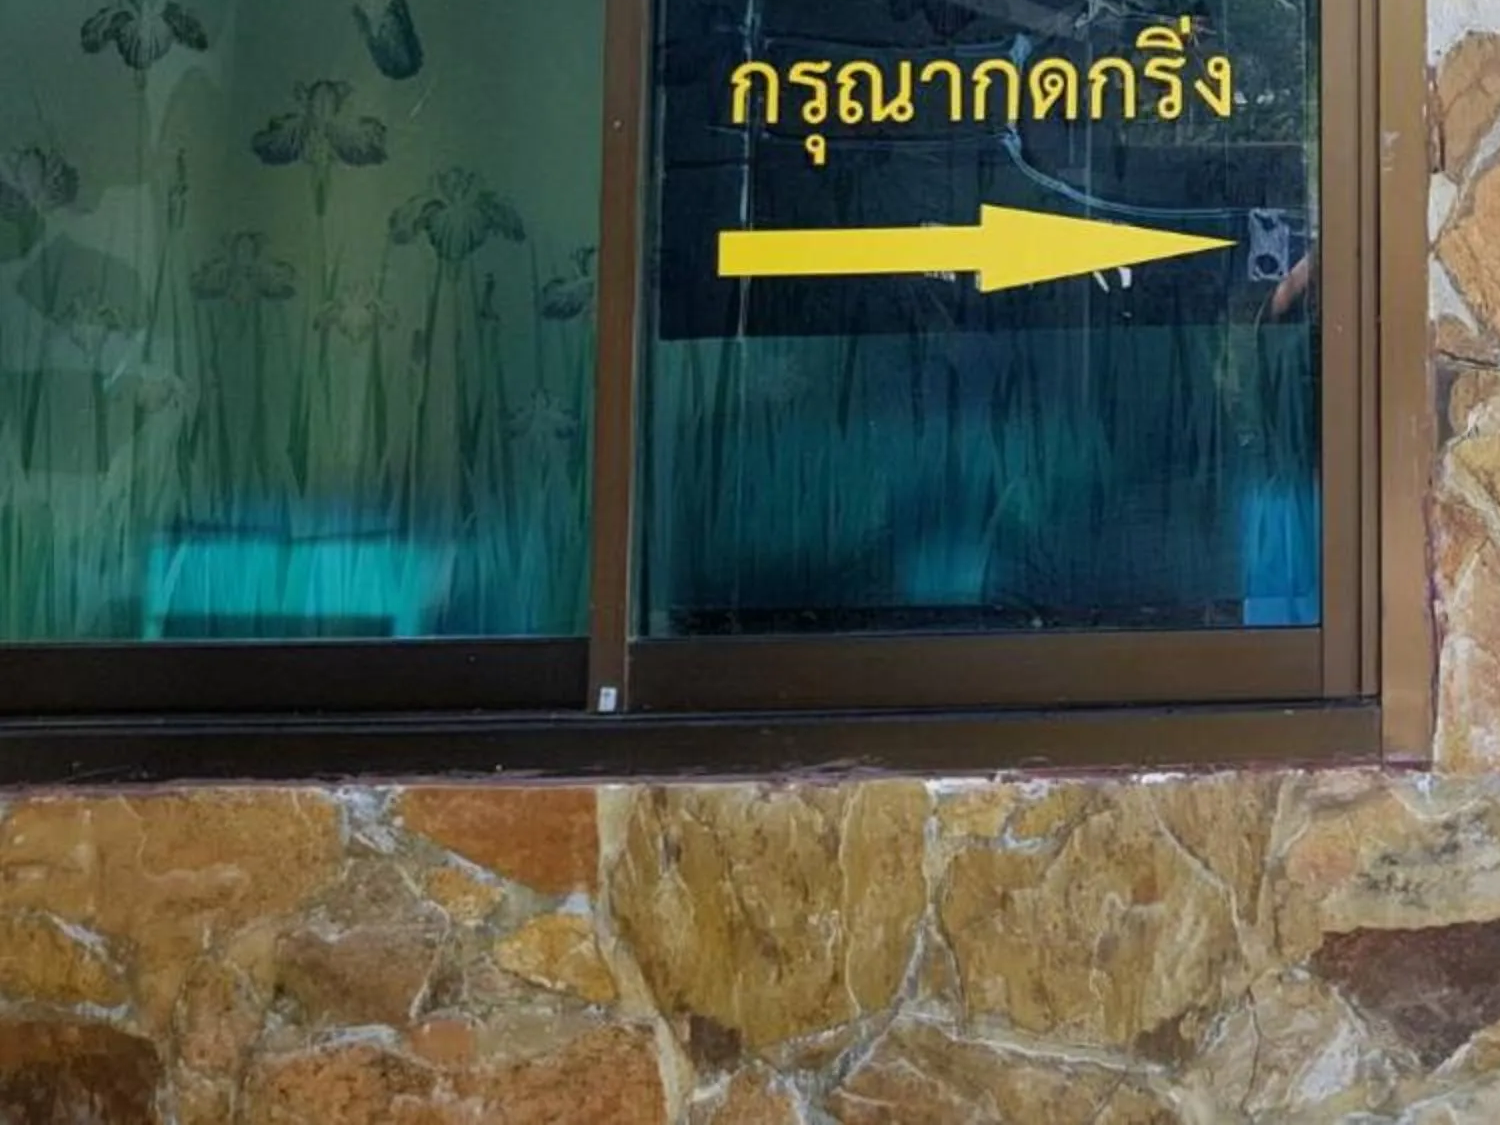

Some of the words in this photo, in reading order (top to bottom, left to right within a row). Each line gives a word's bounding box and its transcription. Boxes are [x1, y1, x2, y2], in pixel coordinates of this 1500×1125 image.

[730, 16, 1233, 166] กรุณากดกริ่ง
